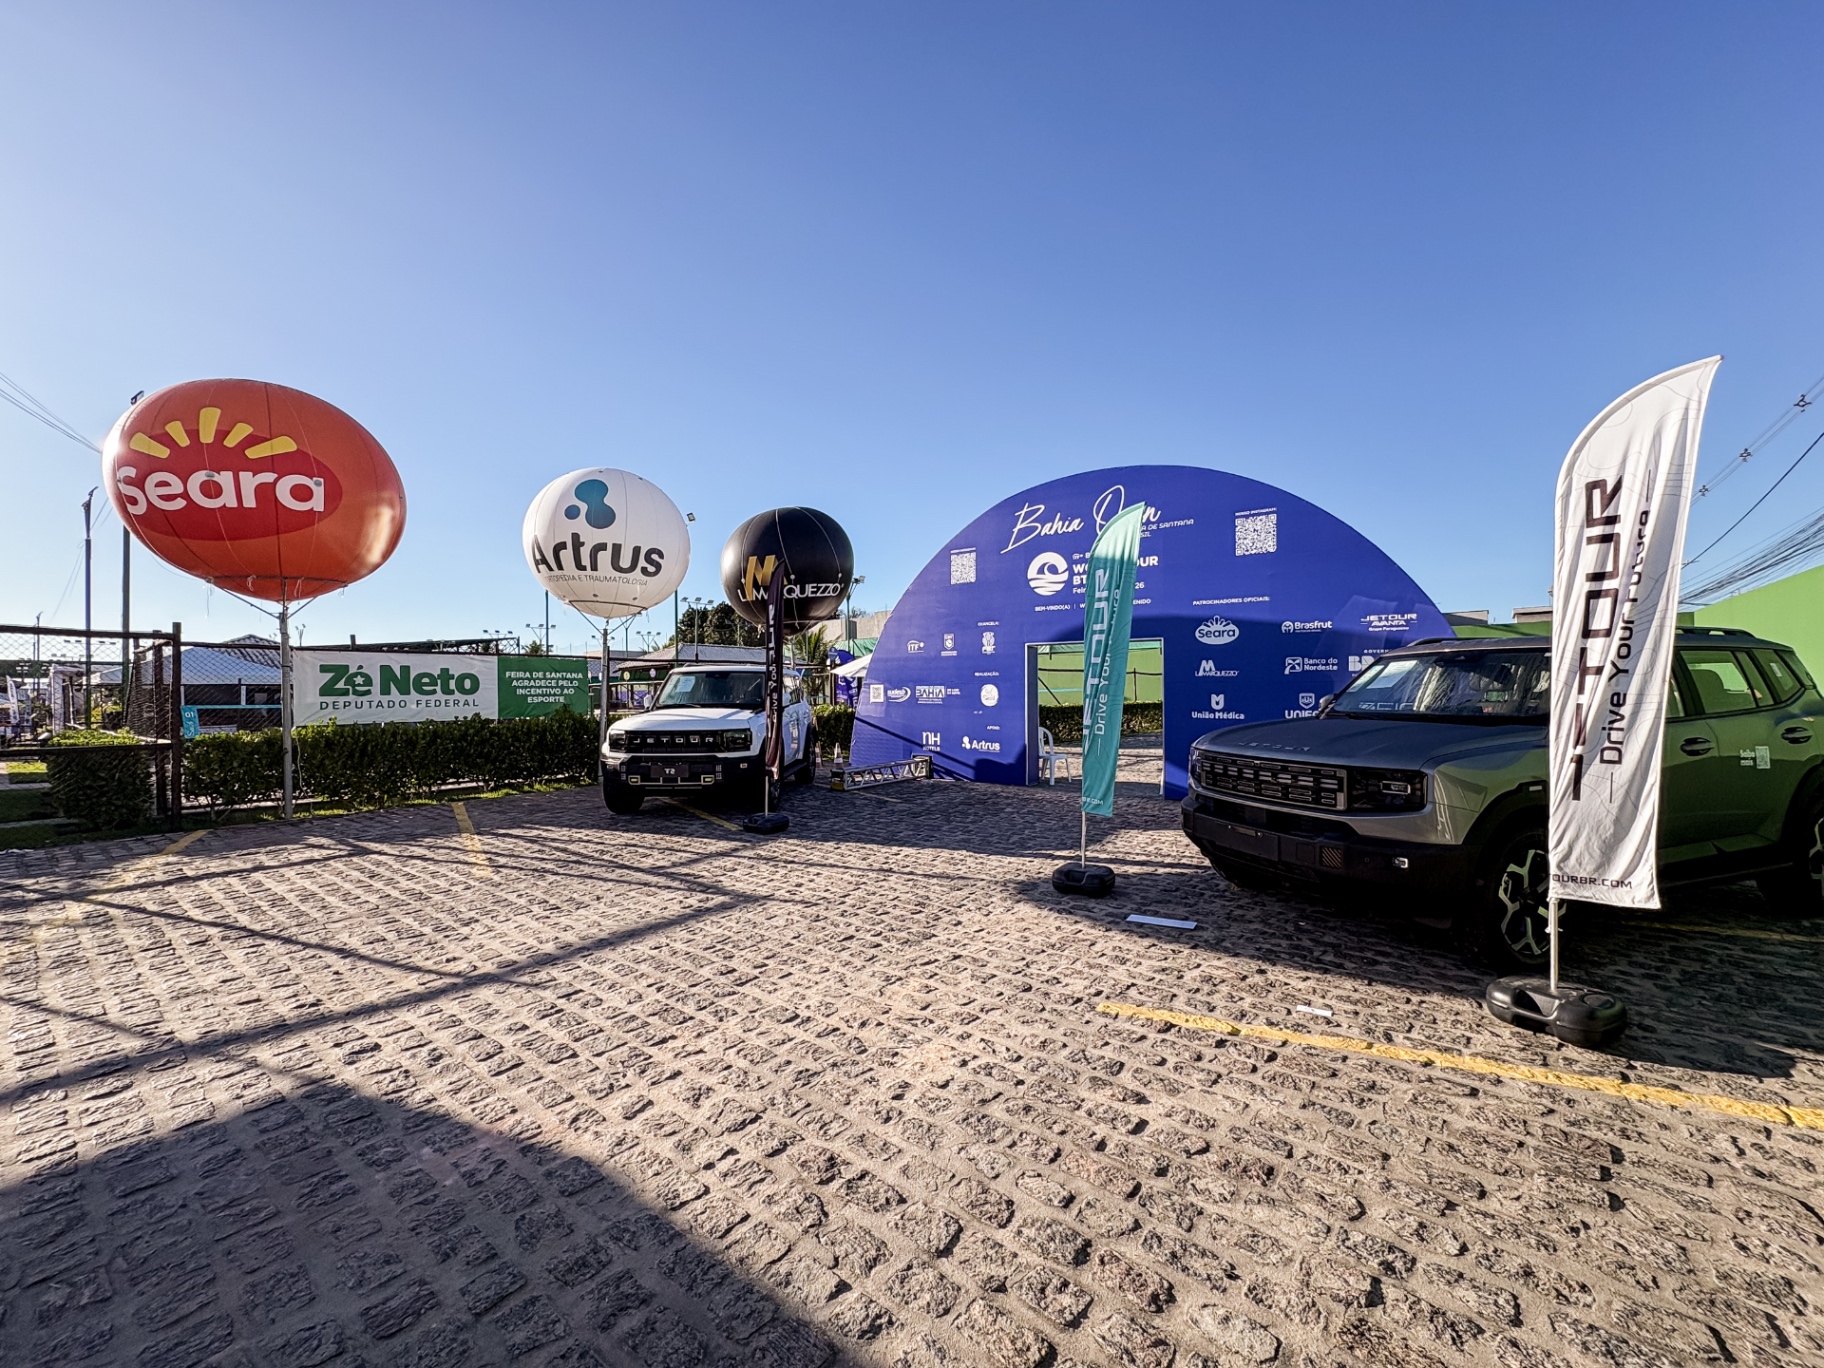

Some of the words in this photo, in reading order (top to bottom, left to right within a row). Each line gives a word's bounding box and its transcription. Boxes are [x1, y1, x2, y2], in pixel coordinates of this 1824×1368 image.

[117, 465, 325, 516] Seara
[1000, 502, 1084, 554] Bahia
[1093, 485, 1162, 536] On
[531, 532, 665, 578] Artrus
[1136, 556, 1159, 567] UR
[1192, 598, 1242, 606] PATROCINADORES
[1360, 613, 1417, 621] JETOUR
[1294, 621, 1333, 629] Brasfrut
[1198, 628, 1236, 639] Seara
[1608, 612, 1634, 682] Your
[318, 664, 373, 697] Zé
[379, 664, 481, 696] Neto
[319, 700, 407, 711] DEPUTADO
[416, 698, 480, 709] FEDERAL
[1094, 693, 1108, 735] Drive
[1191, 711, 1214, 719] União
[1215, 711, 1245, 720] Médica
[1599, 691, 1627, 765] Drive
[633, 736, 714, 744] JETOUR
[971, 739, 1000, 751] Artrus
[1550, 873, 1633, 890] OURBR.COM
